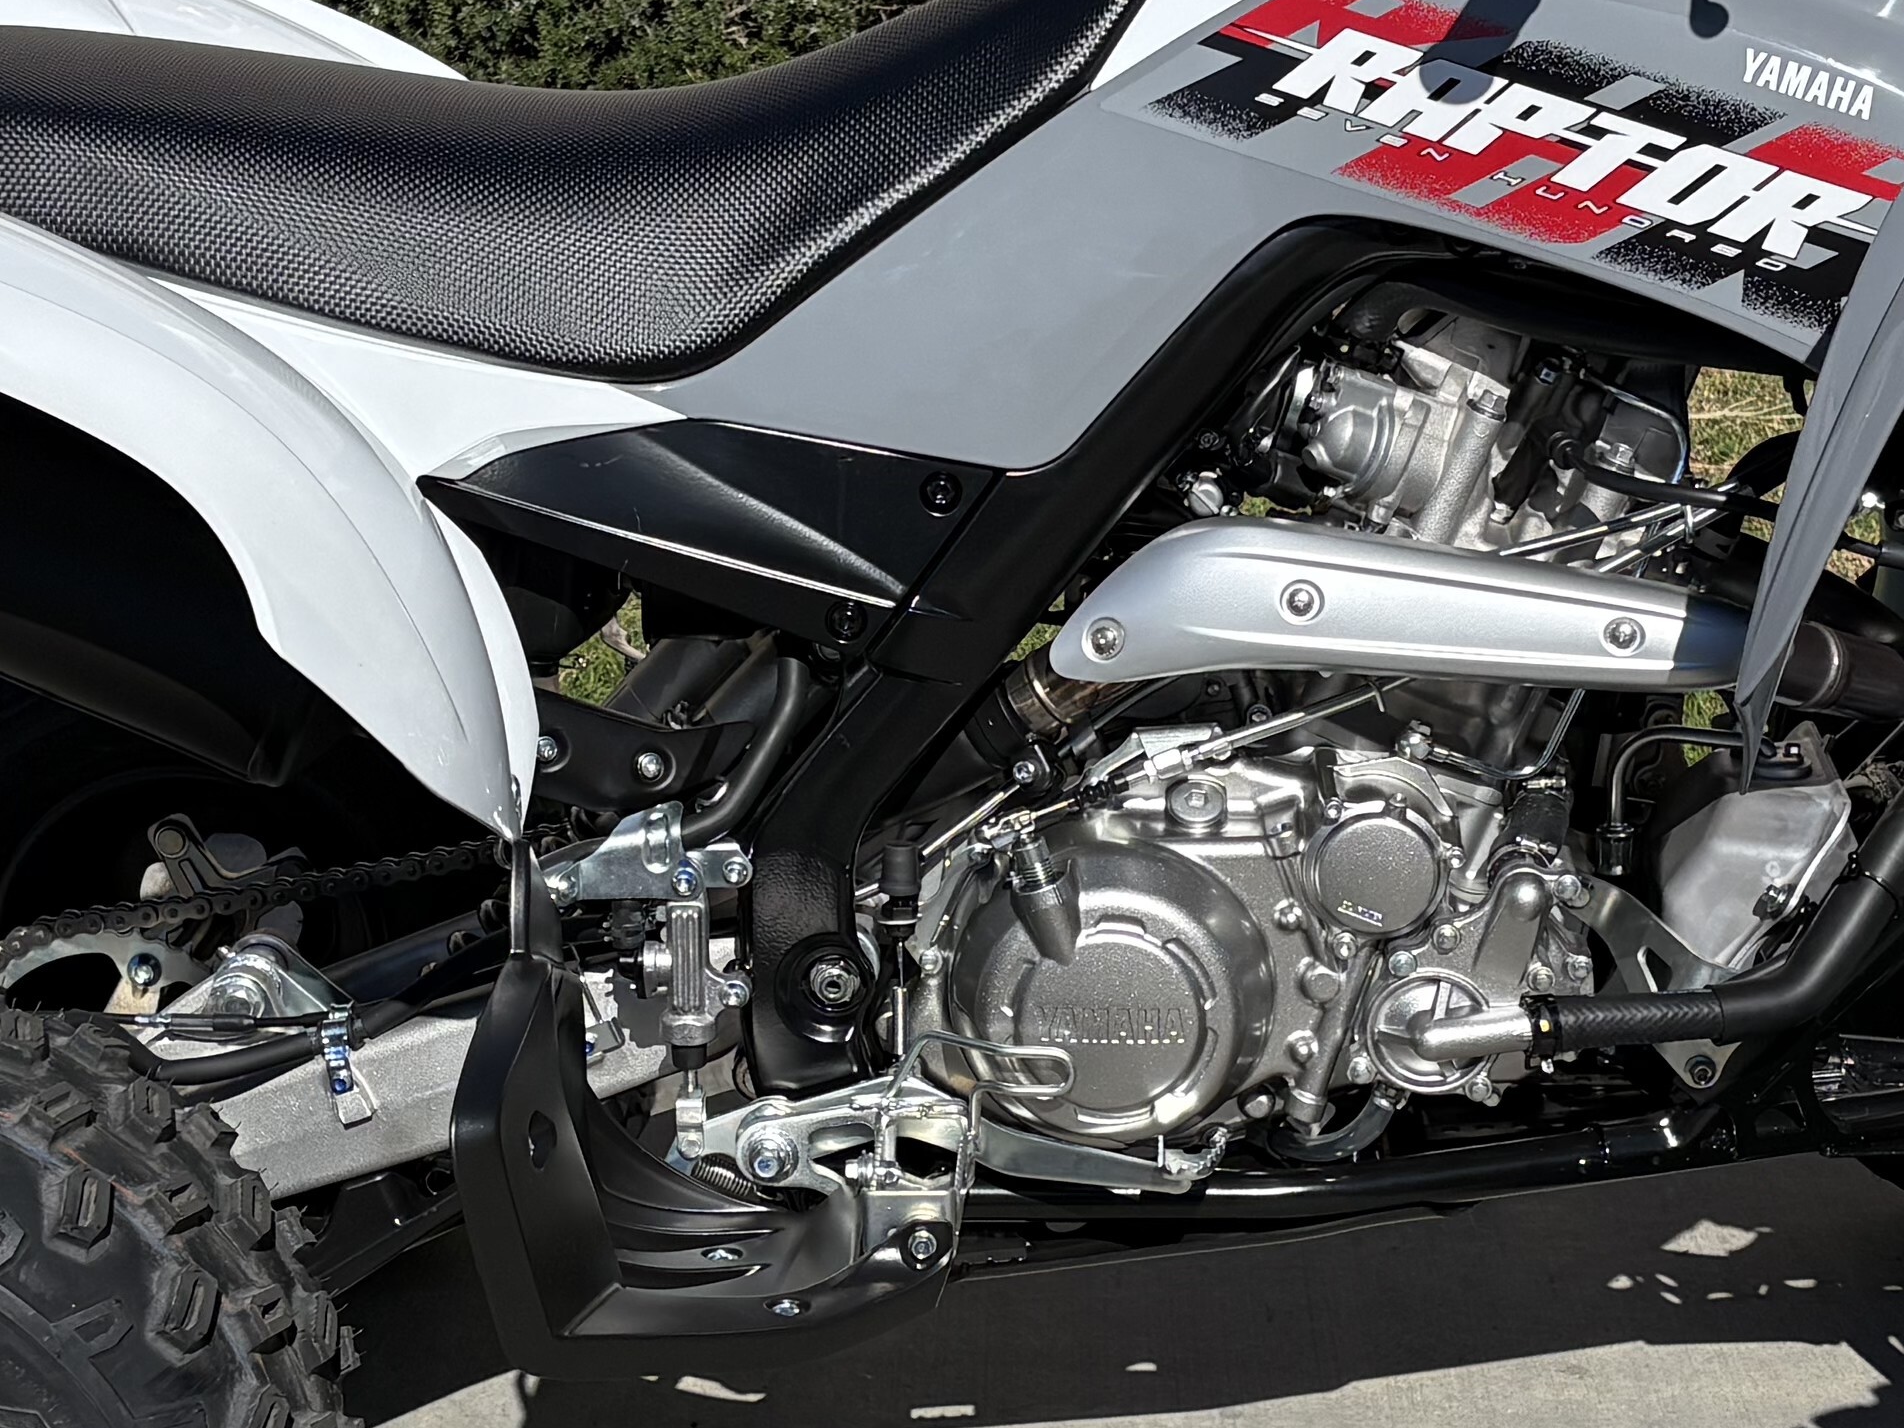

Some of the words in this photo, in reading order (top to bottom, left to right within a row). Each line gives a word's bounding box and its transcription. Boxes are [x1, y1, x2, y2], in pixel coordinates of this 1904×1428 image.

[1742, 47, 1875, 122] YAMAHA
[1261, 27, 1881, 262] RAPTOR
[1036, 1005, 1186, 1045] YAMAHA
